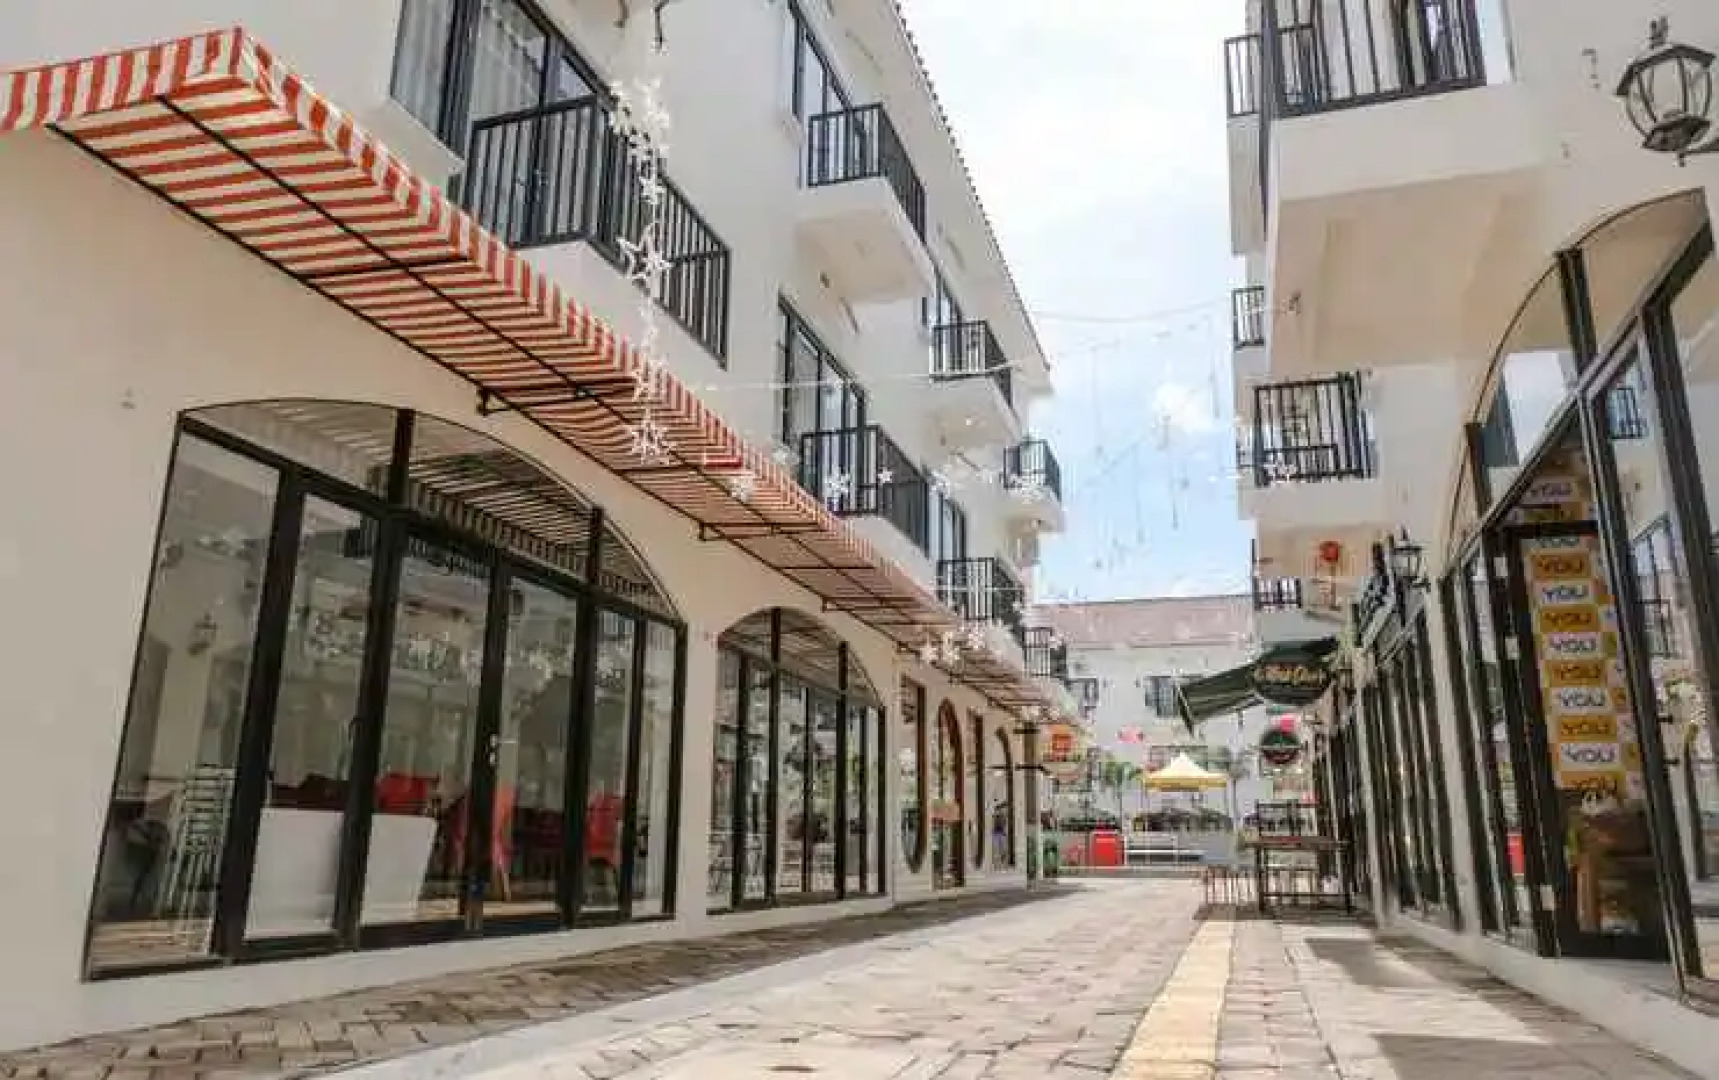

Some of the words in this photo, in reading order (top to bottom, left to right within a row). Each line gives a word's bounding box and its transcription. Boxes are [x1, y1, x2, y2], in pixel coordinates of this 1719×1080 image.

[1536, 556, 1585, 574] YOU
[1542, 585, 1589, 601] YOU
[1543, 611, 1592, 627] YOU
[1548, 638, 1598, 653] YOU
[1553, 664, 1602, 681] YOU
[1557, 689, 1606, 706] YOU
[1560, 719, 1611, 735] YOU
[1563, 745, 1616, 763] YOU
